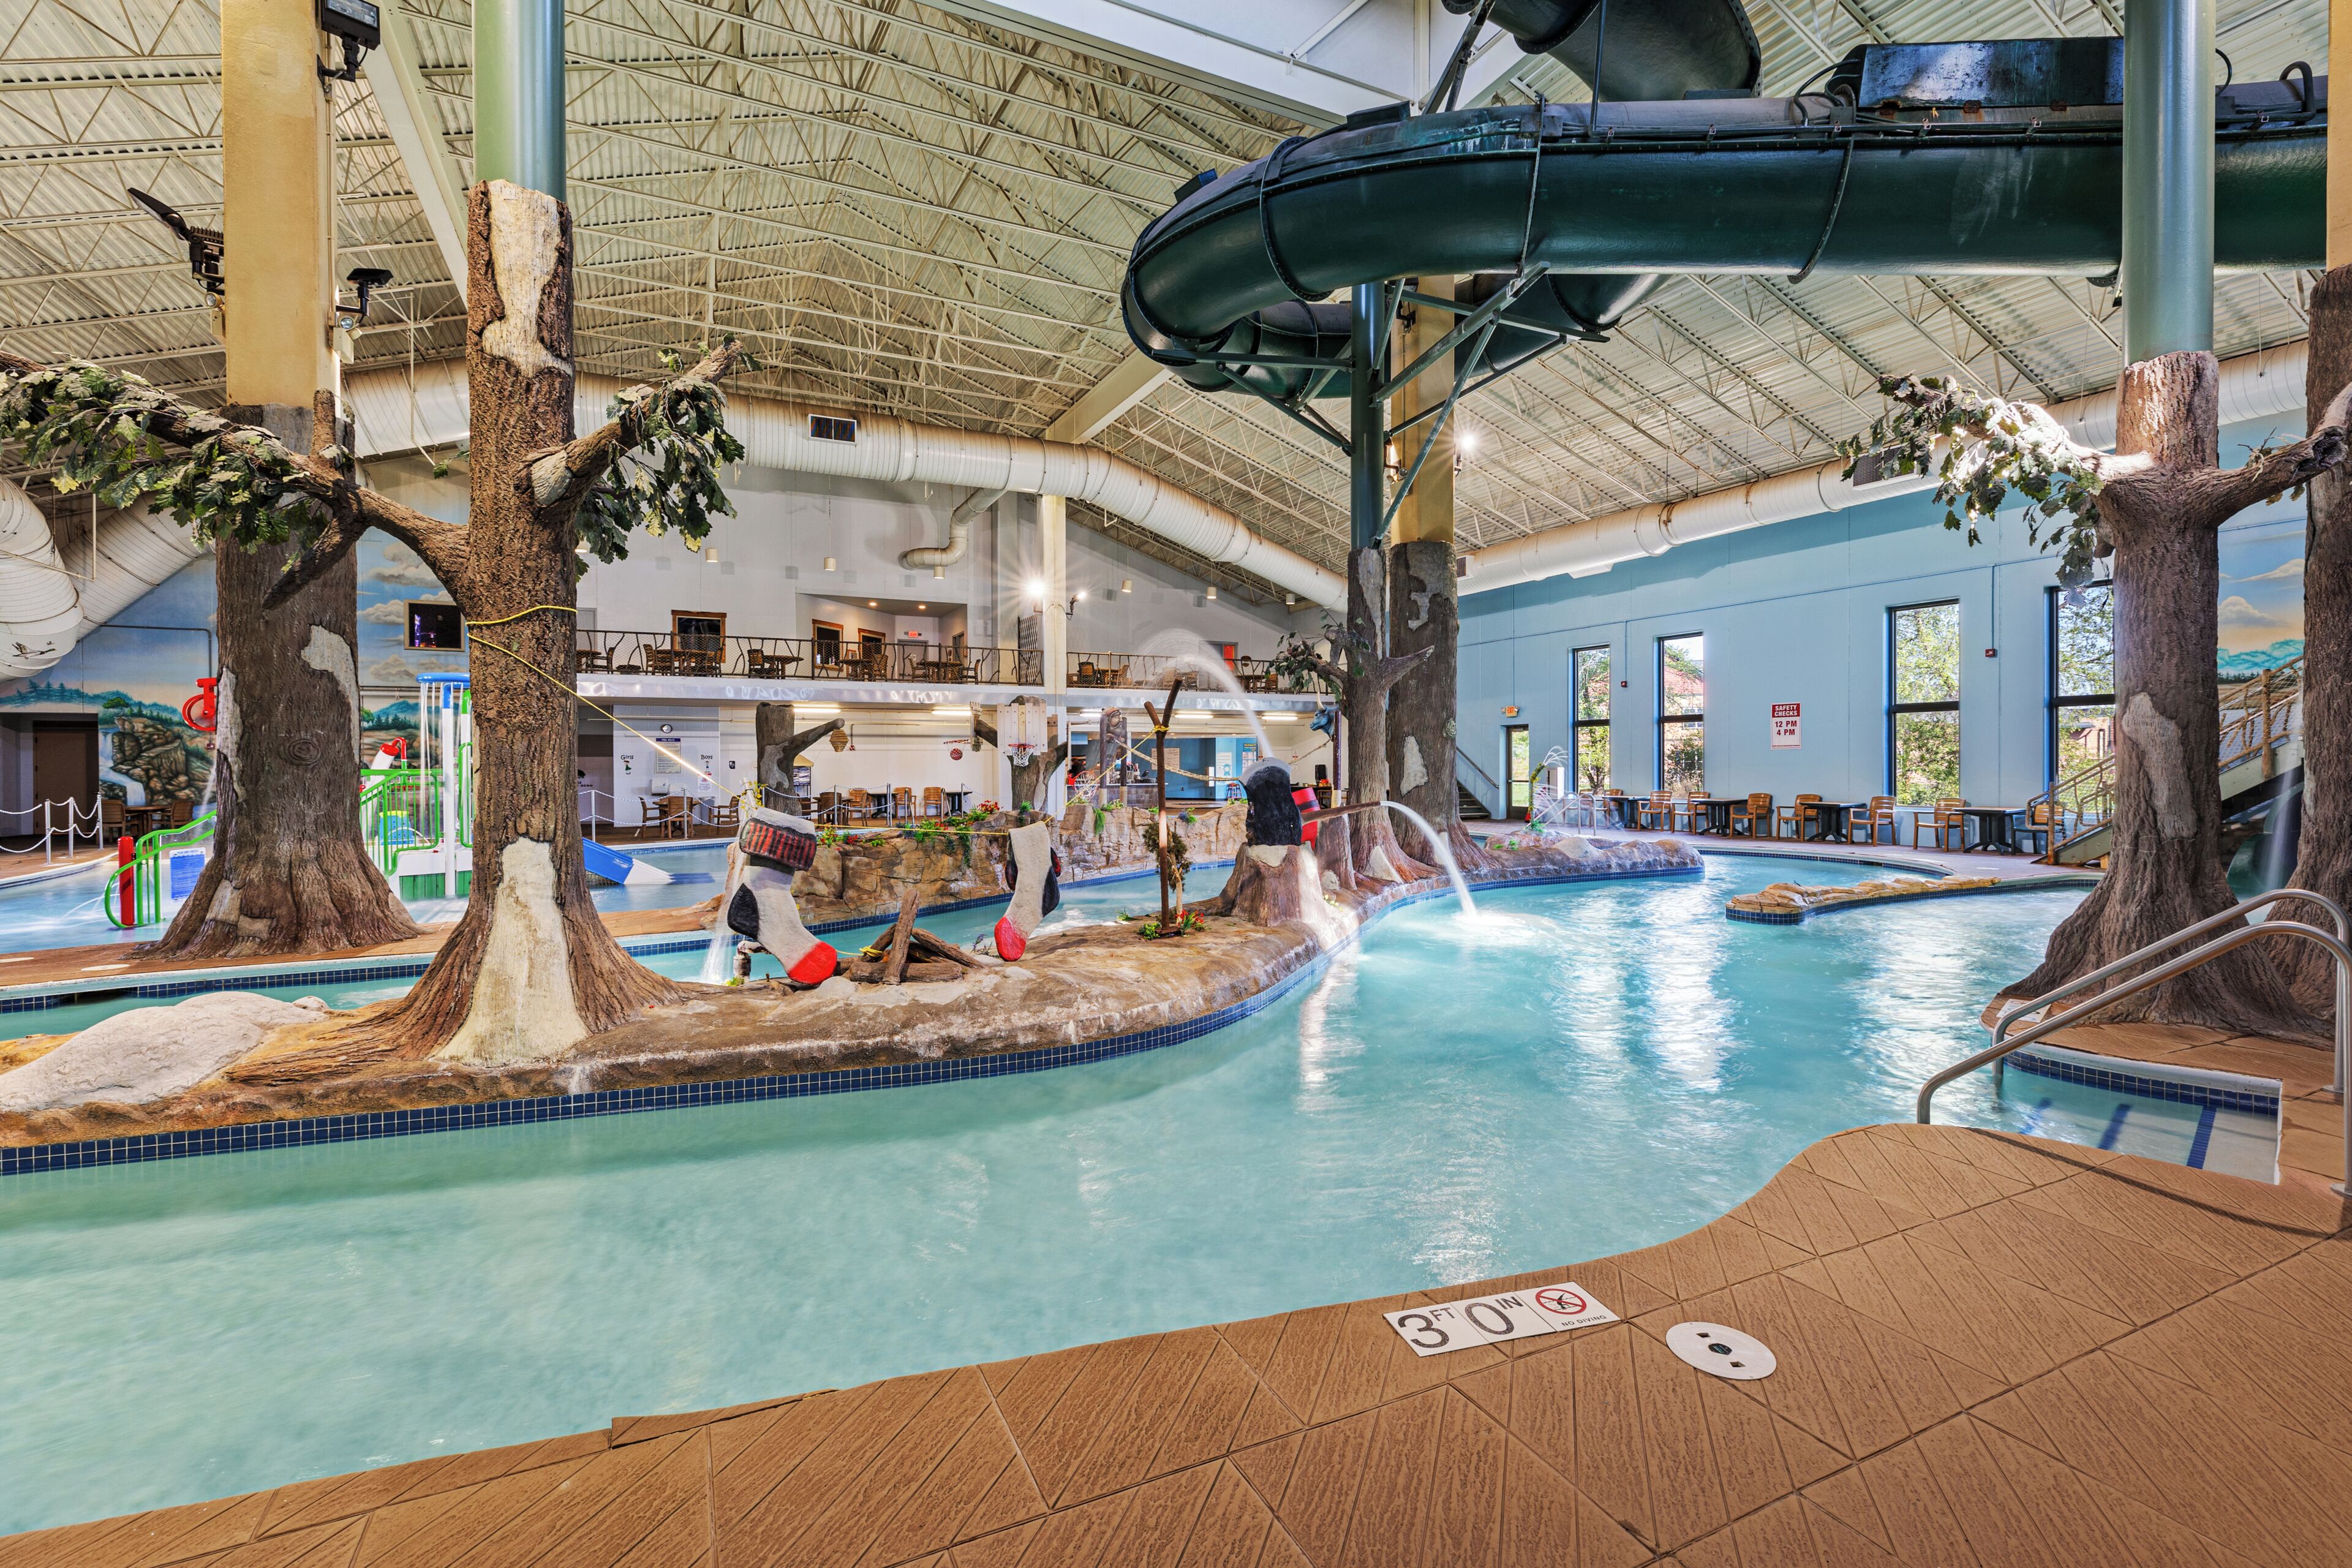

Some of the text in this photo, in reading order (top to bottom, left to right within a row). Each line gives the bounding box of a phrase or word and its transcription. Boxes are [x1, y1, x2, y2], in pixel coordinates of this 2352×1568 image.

[1397, 1296, 1523, 1348] 3 FT 0 IN
[1578, 1315, 1607, 1324] DIVING
